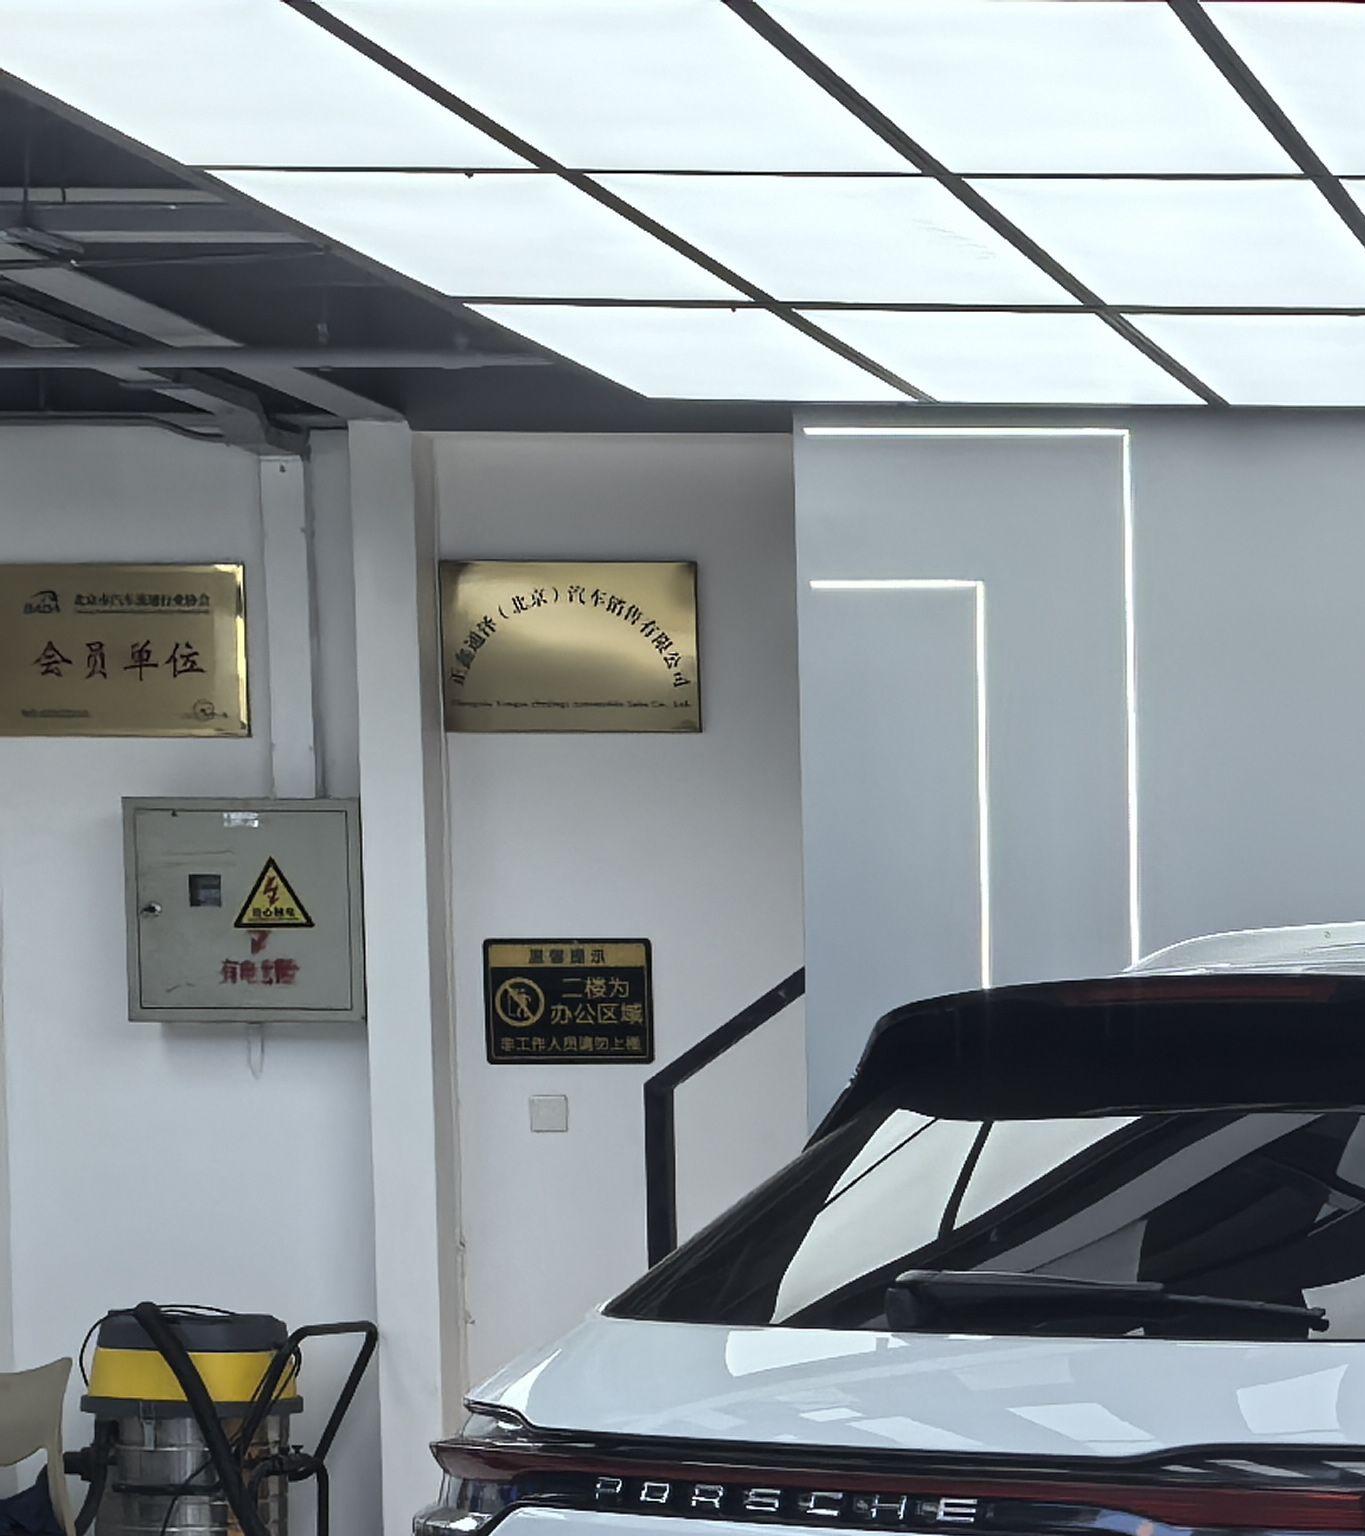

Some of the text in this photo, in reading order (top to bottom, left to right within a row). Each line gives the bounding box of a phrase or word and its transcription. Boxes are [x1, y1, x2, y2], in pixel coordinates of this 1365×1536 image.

[33, 640, 205, 682] 会员单位
[561, 976, 630, 999] 二楼为
[550, 1003, 644, 1025] 办公区域
[501, 1036, 642, 1052] 非工作人员请勿上楼
[595, 1477, 978, 1523] PORSCHE
